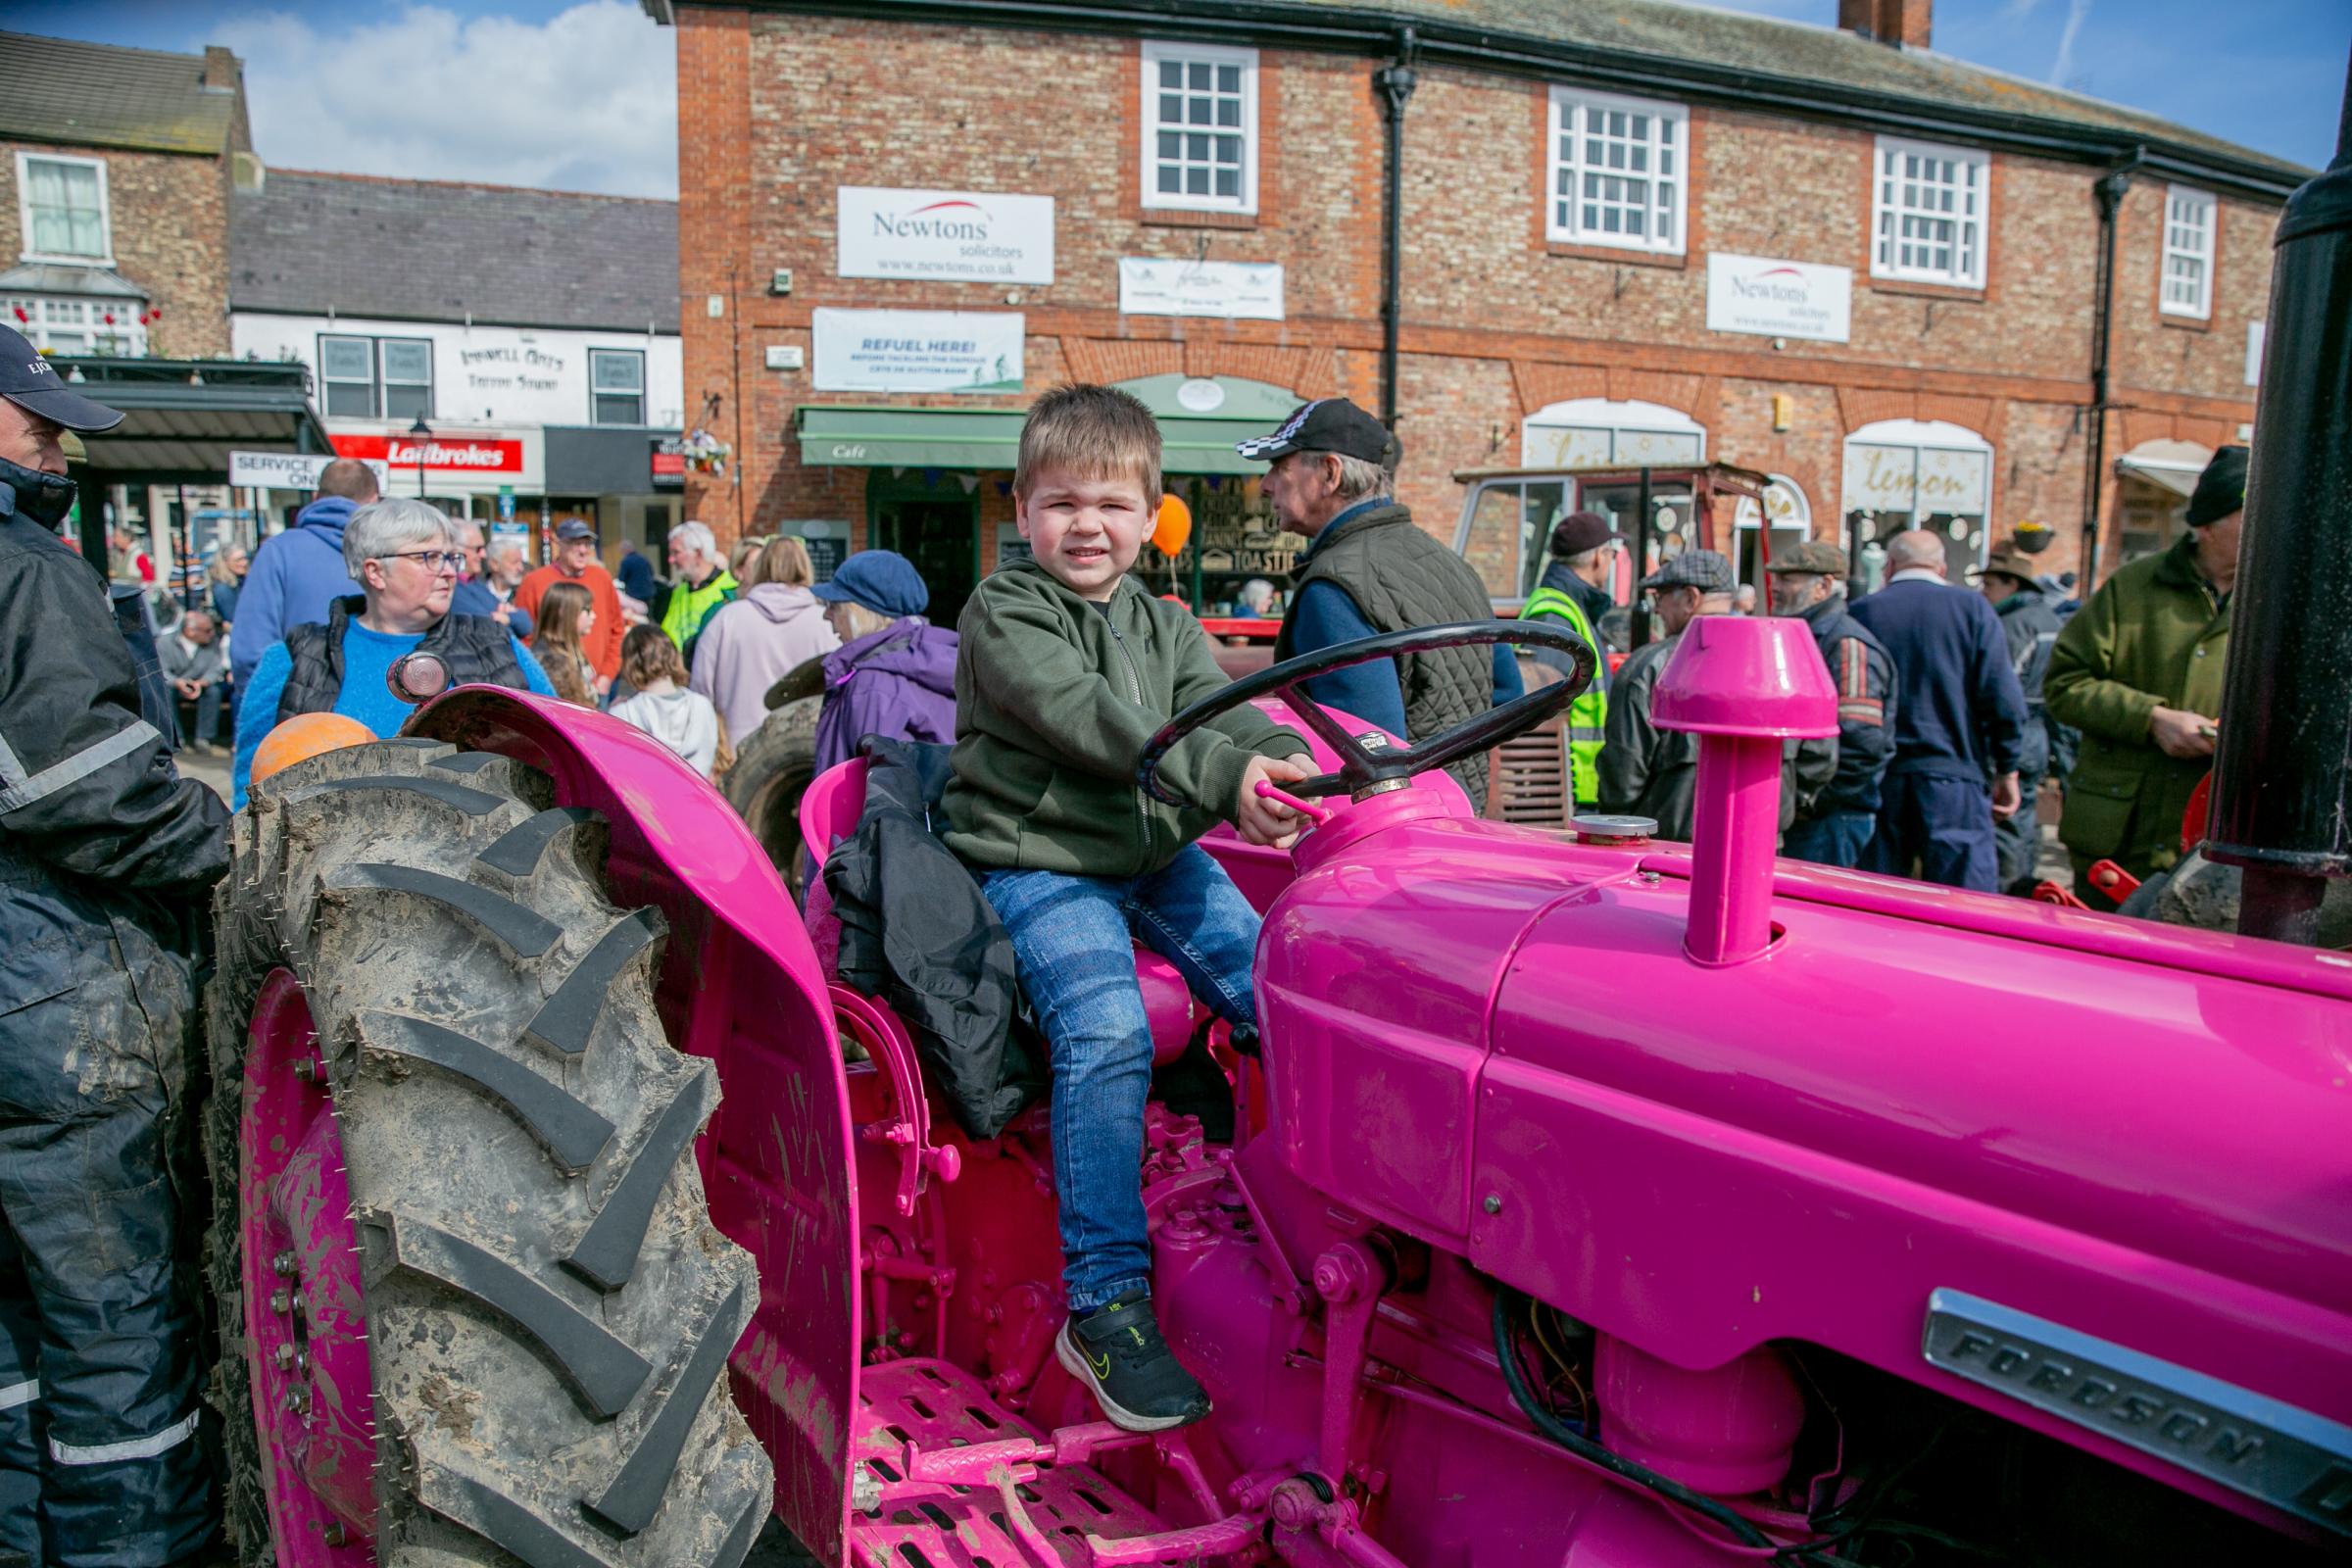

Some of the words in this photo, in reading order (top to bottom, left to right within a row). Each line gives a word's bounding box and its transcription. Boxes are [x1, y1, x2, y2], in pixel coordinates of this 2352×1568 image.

[873, 212, 988, 241] Newtons
[959, 244, 1023, 259] solicitors
[877, 259, 1015, 275] www.newtons.co.uk
[1732, 275, 1808, 303] Newtons
[861, 338, 923, 353] REFUEL
[927, 340, 976, 354] HERE!
[236, 456, 314, 472] SERVICE
[388, 441, 505, 466] Ladbrokes
[1866, 452, 1967, 497] lemon
[1950, 1330, 2264, 1468] FORDSON
